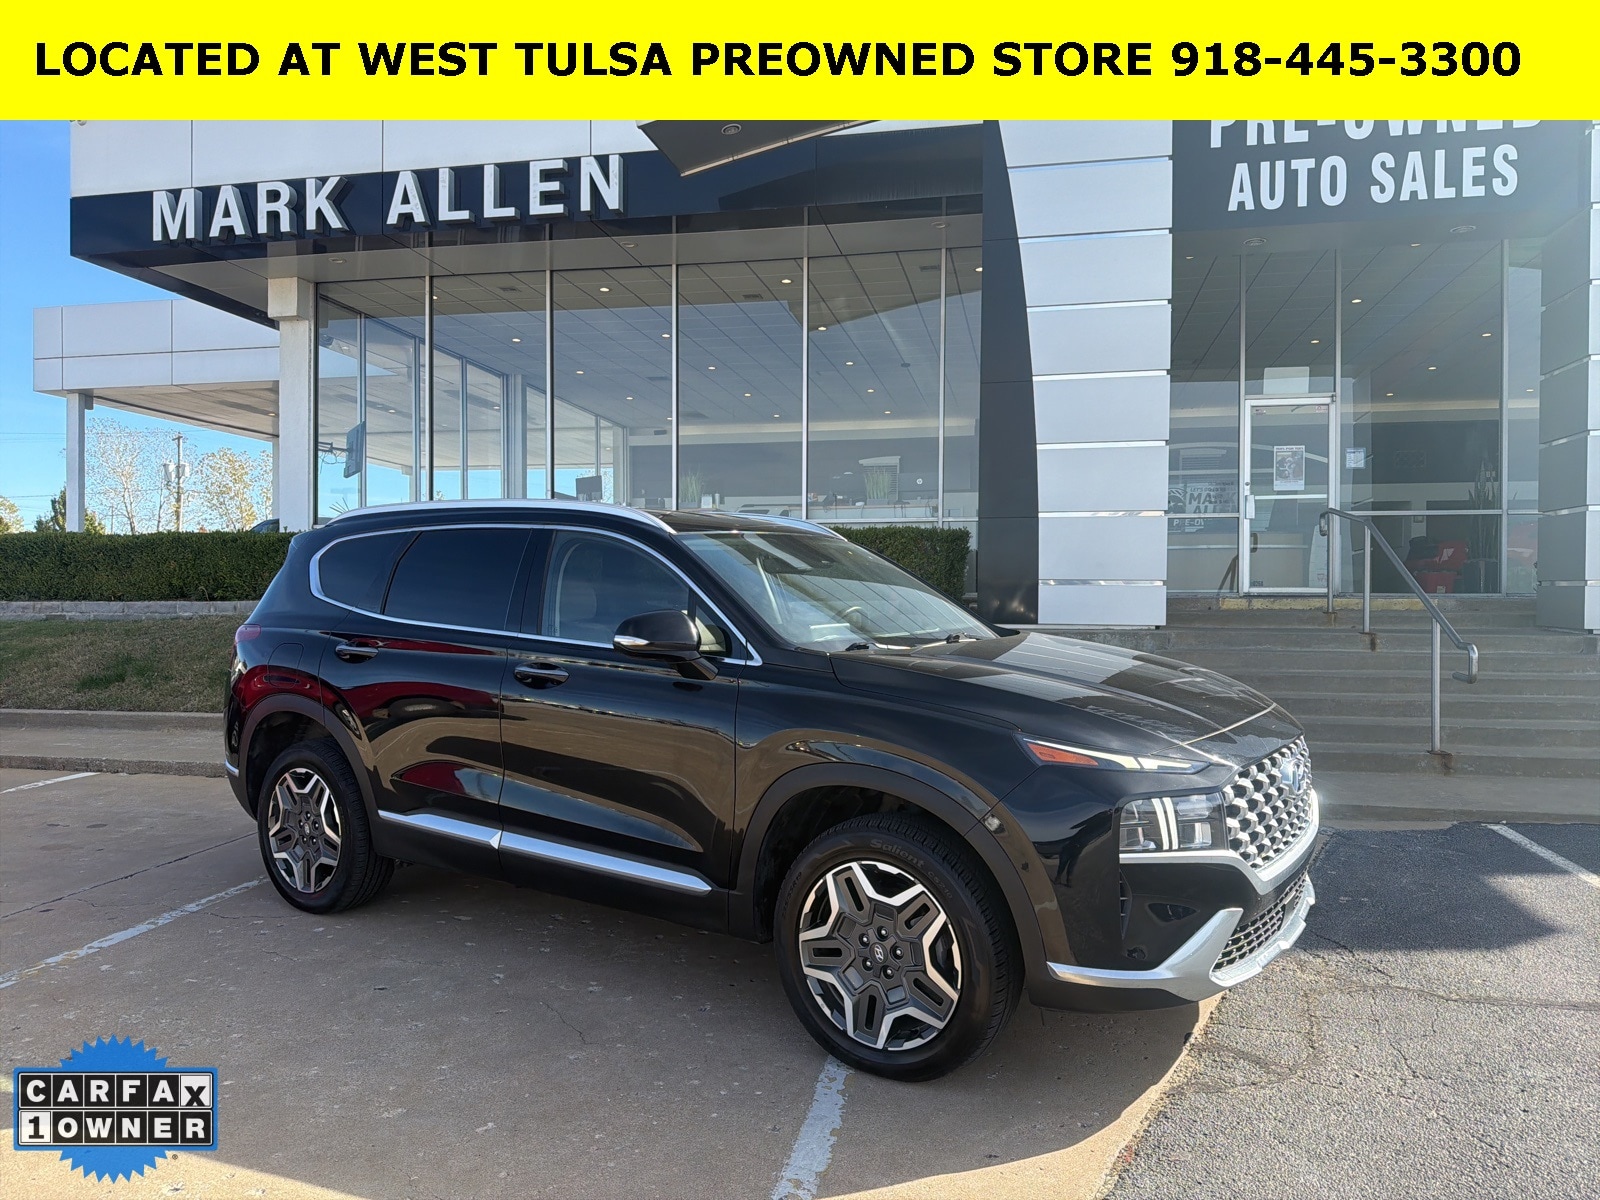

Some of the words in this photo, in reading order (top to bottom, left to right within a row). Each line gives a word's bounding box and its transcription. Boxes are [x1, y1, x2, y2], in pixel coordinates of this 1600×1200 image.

[152, 177, 348, 242] MARK
[385, 154, 625, 226] ALLEN
[1227, 155, 1348, 212] AUTO
[1370, 144, 1519, 204] SALES
[869, 838, 925, 868] Salient
